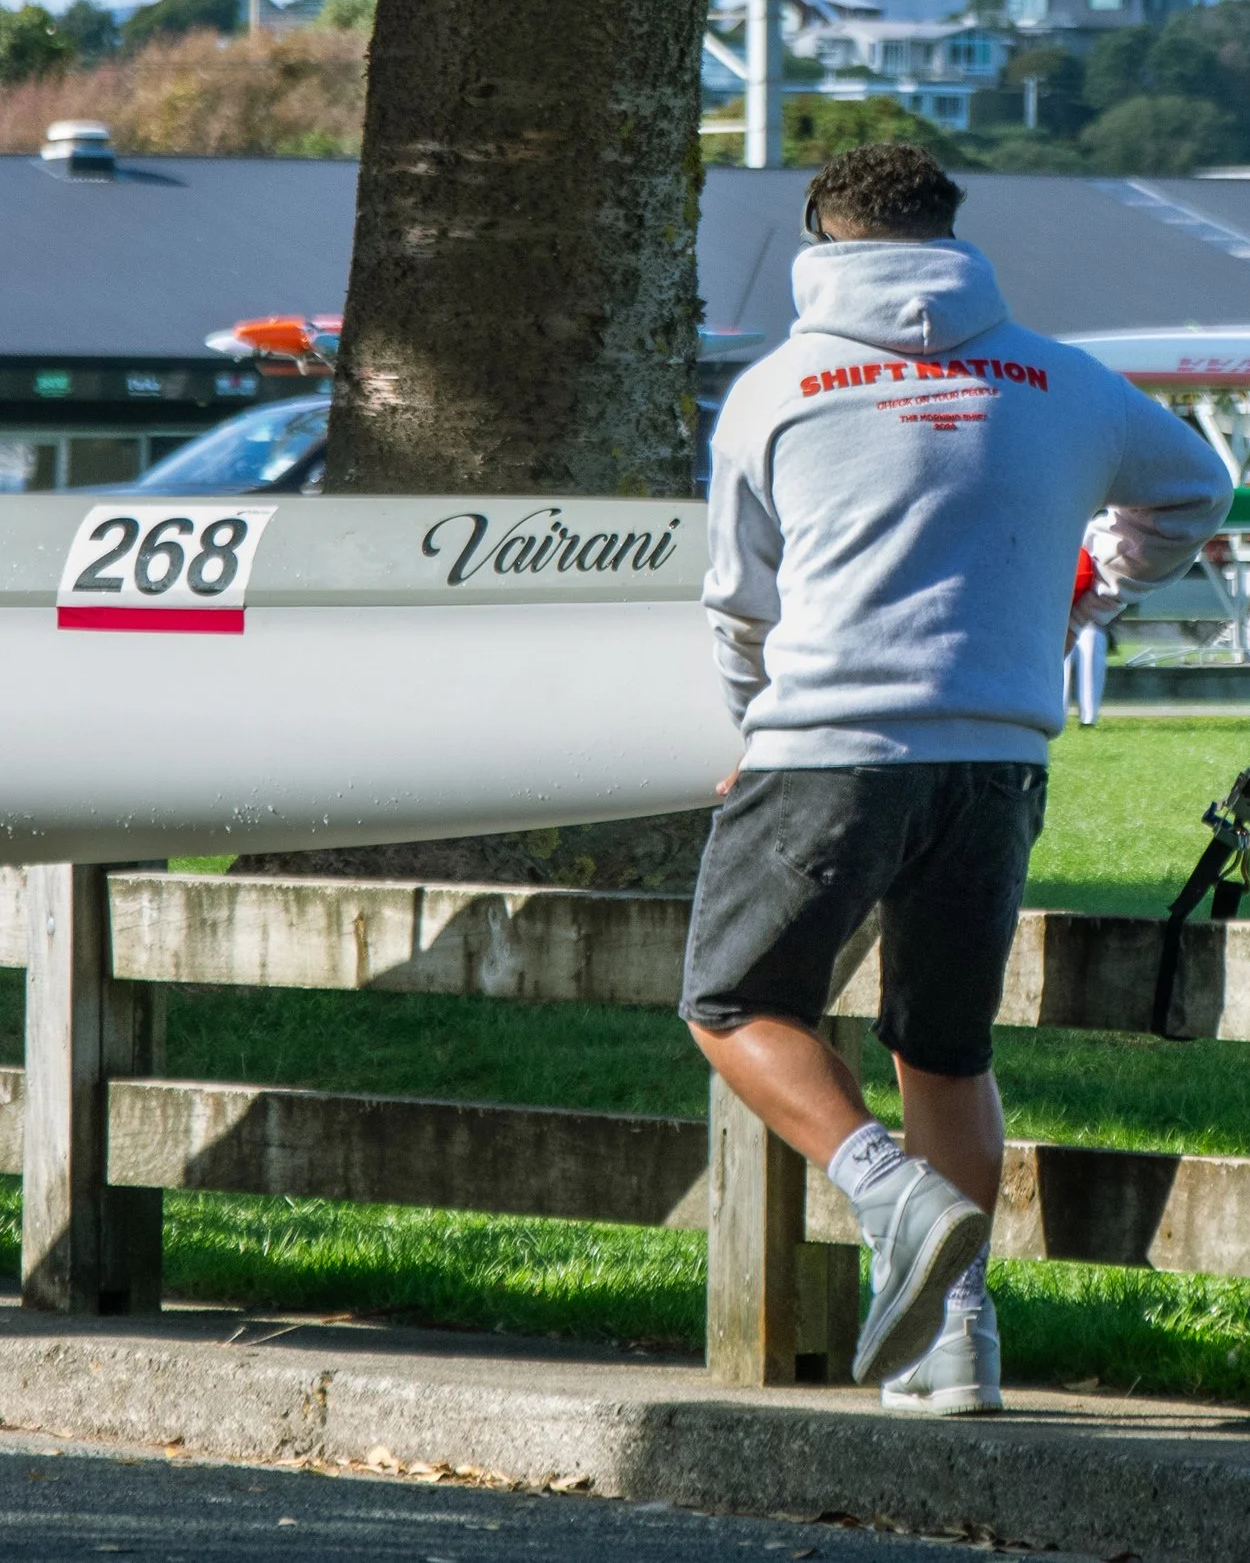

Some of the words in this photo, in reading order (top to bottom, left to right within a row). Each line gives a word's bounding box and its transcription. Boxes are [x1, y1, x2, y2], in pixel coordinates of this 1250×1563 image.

[799, 362, 908, 398] SHIFT
[914, 358, 1049, 393] NATION
[876, 397, 912, 411] CHECK
[915, 394, 930, 405] ON
[931, 389, 959, 403] YOUR
[961, 386, 998, 397] PEOPLE
[899, 413, 918, 423] THE
[919, 413, 961, 423] MORNING
[962, 412, 987, 423] SHIFT
[71, 517, 249, 598] 268
[421, 508, 681, 587] Vairani
